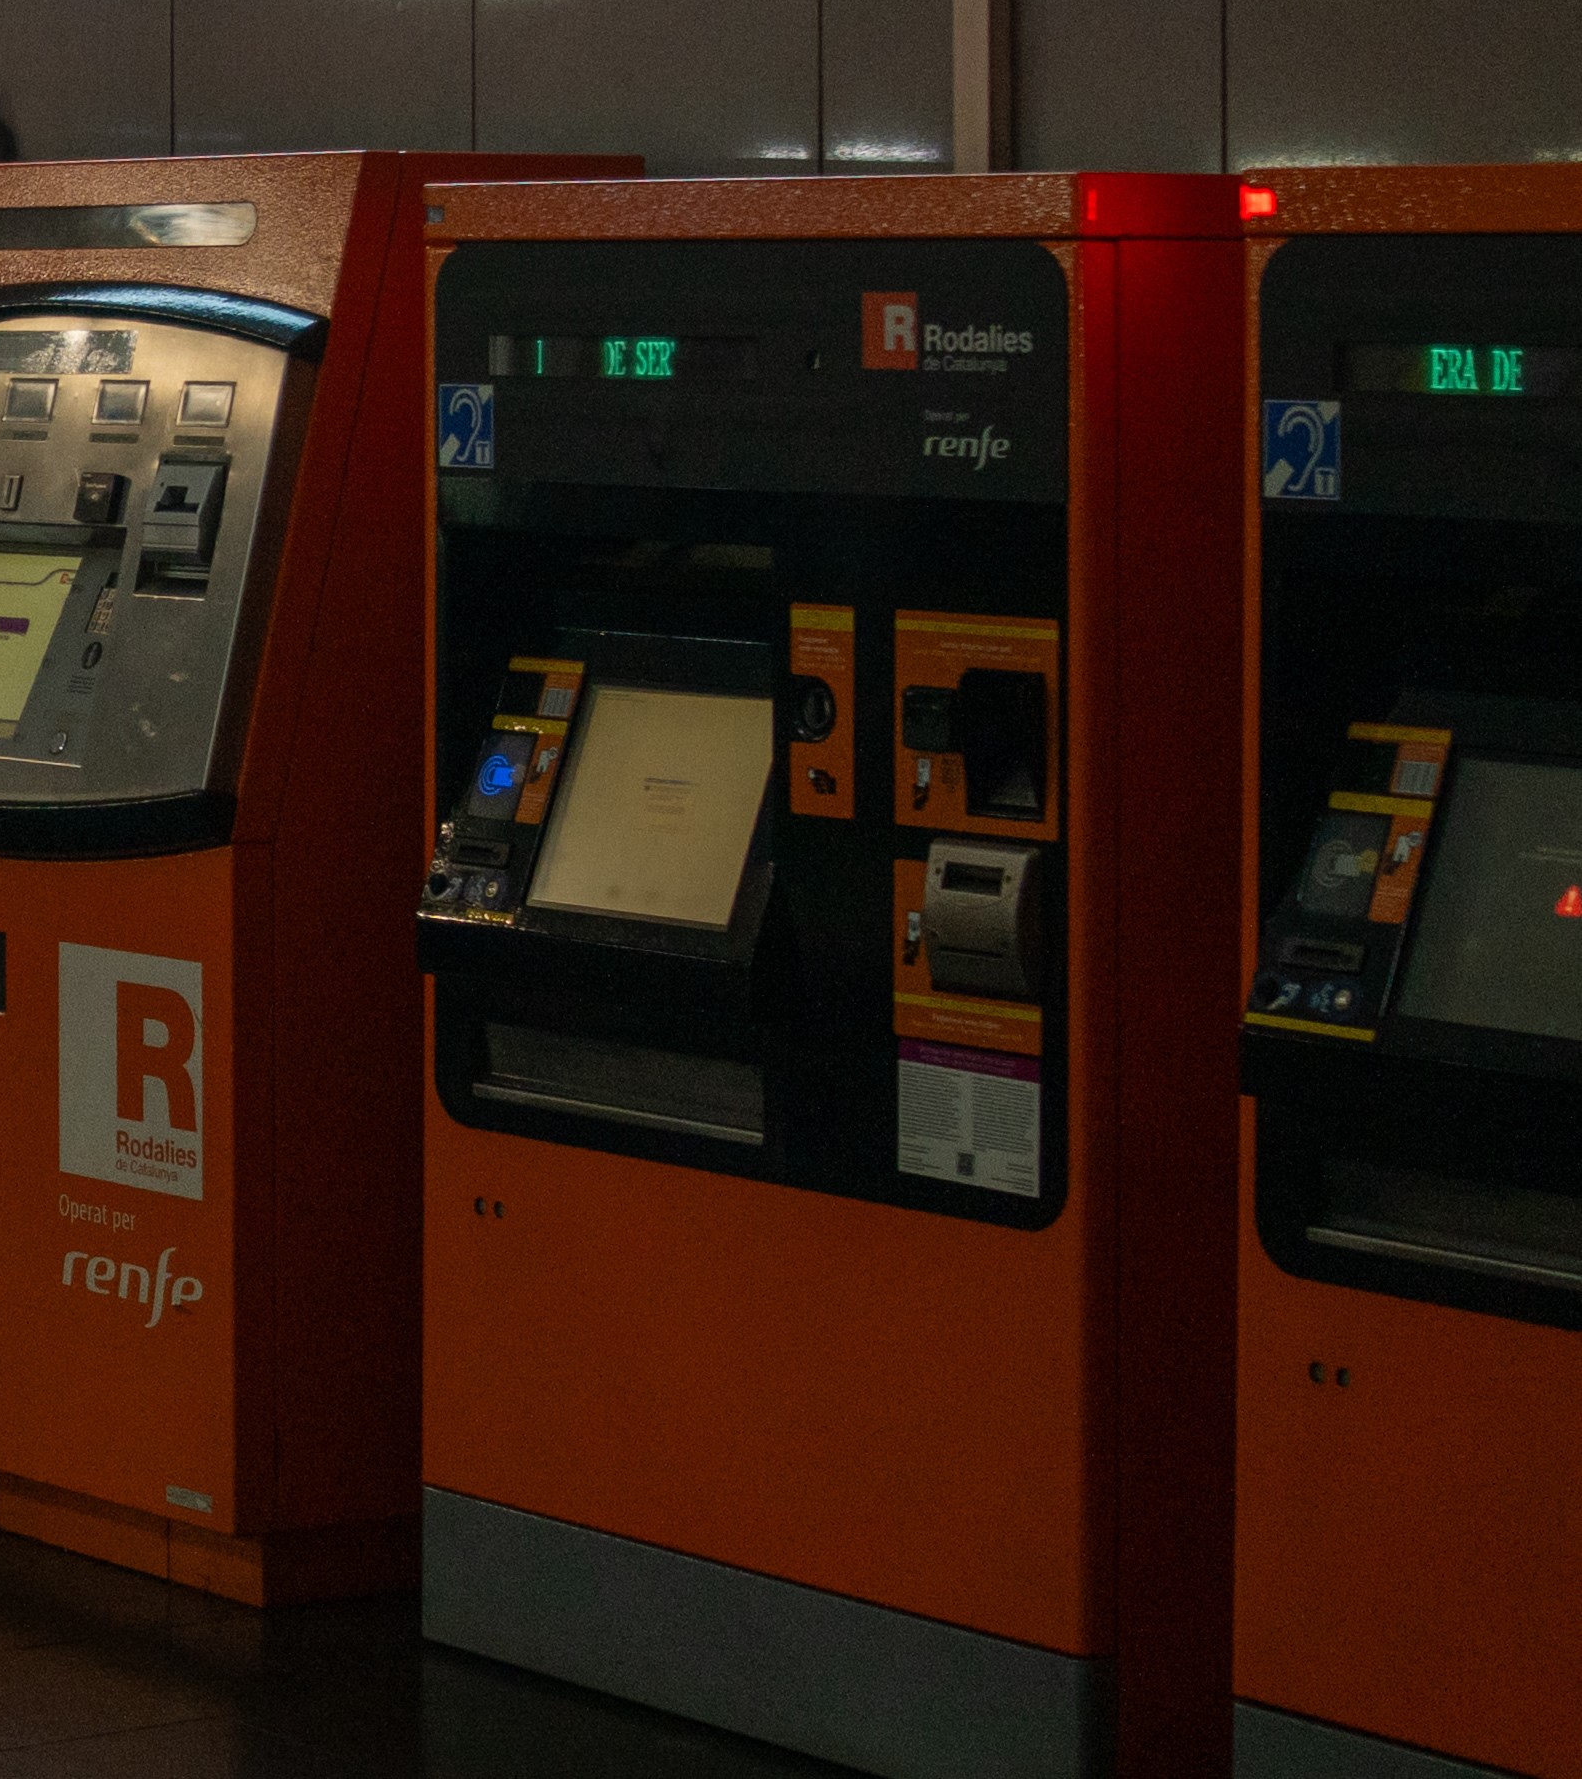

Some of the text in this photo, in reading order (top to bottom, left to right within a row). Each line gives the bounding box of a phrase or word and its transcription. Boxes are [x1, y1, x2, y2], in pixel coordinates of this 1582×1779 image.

[883, 304, 916, 351] R
[923, 323, 1034, 353] Rodalies
[1430, 348, 1523, 391] ERA DE
[923, 424, 1011, 471] renfe
[117, 980, 197, 1133] R
[115, 1158, 179, 1184] de Catalunya
[116, 1130, 197, 1169] Rodalies
[58, 1194, 137, 1232] Operat per
[61, 1246, 204, 1329] renfe
